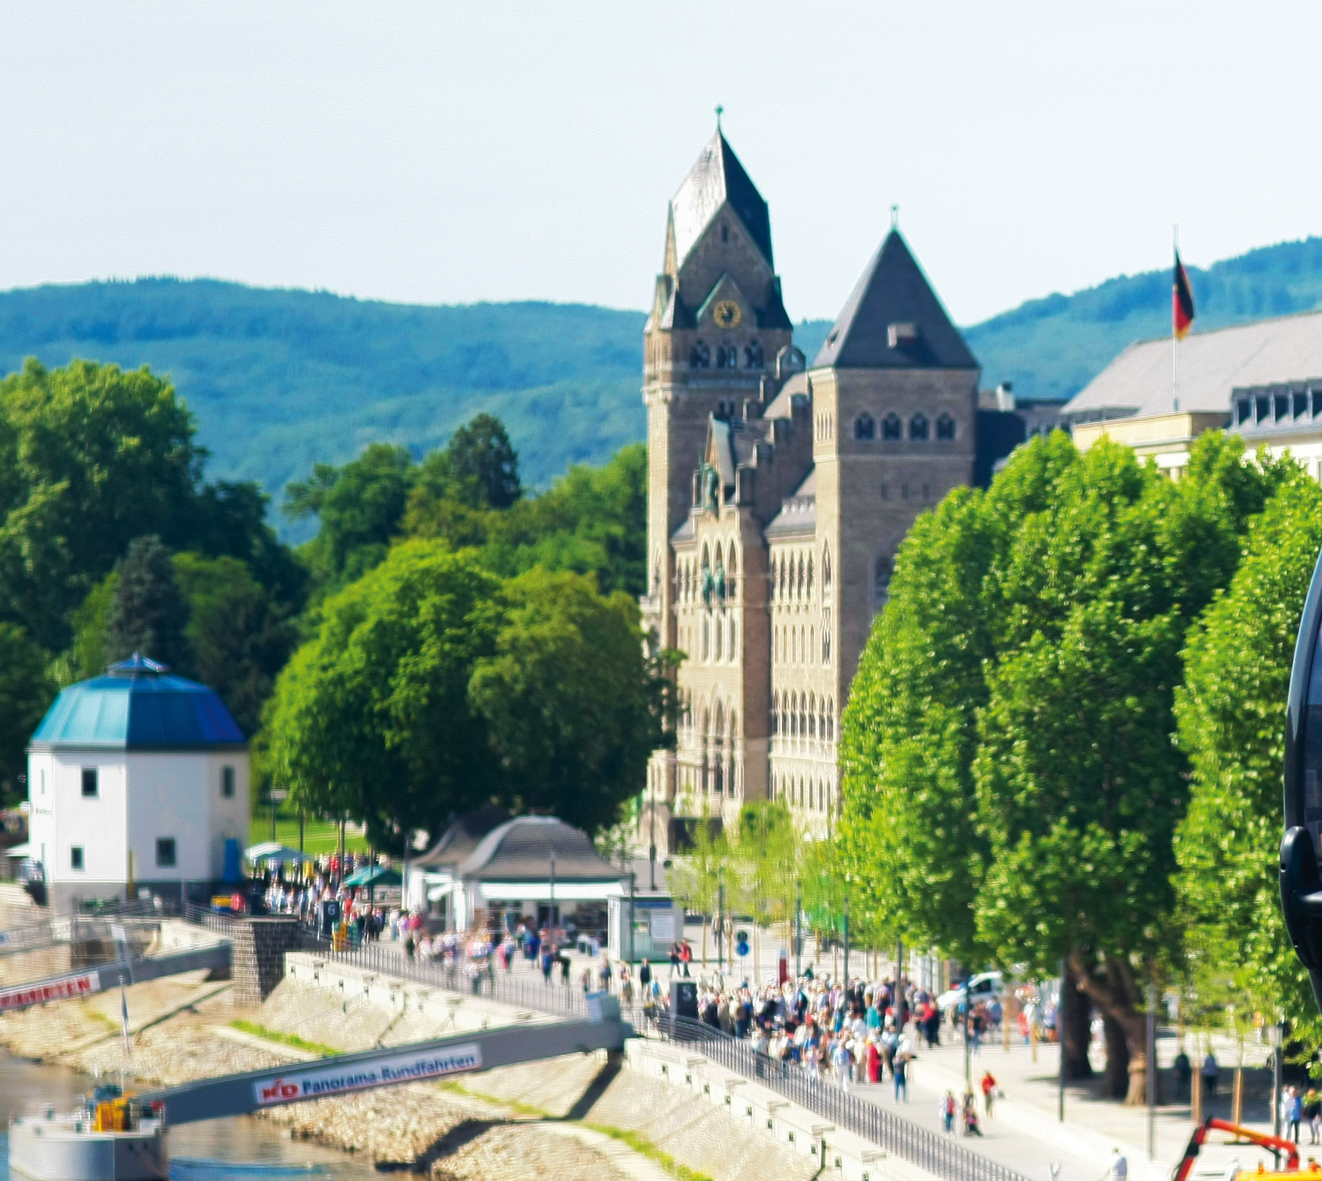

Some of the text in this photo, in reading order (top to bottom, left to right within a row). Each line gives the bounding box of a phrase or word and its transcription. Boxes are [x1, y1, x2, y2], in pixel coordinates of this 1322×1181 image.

[327, 903, 336, 916] 6
[682, 985, 692, 1001] 5
[302, 1055, 477, 1094] Panorama-Rundfahrten
